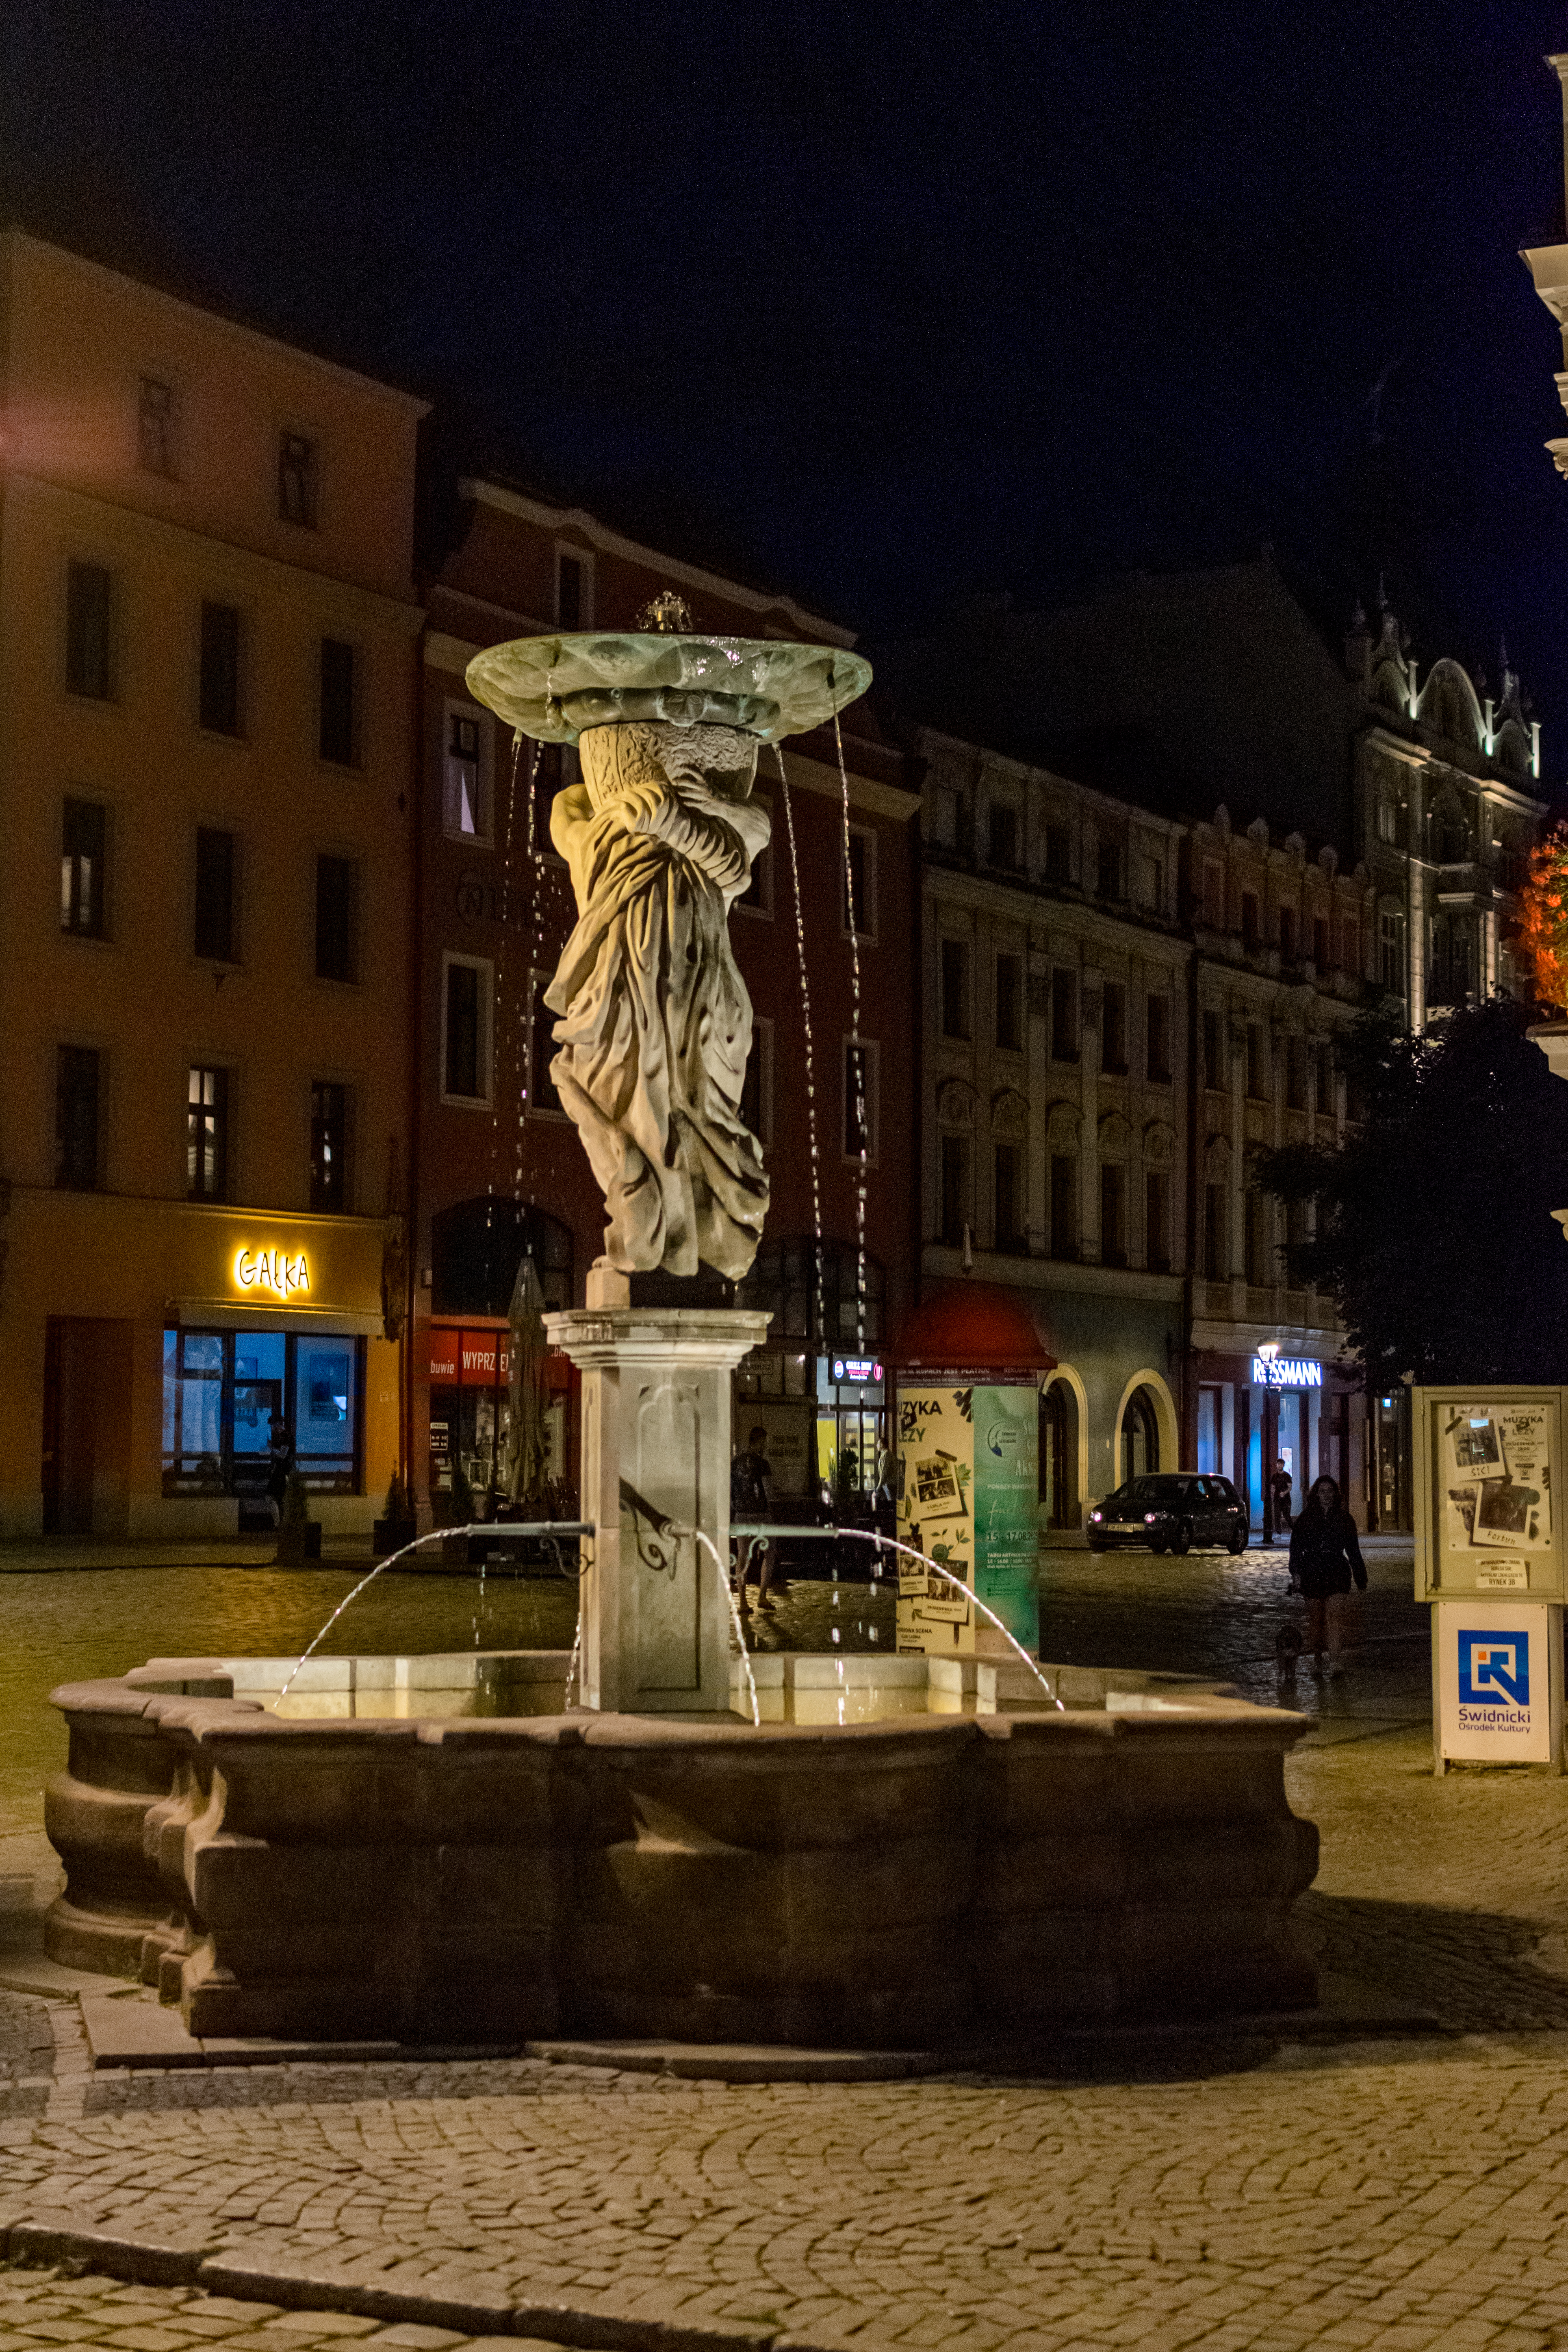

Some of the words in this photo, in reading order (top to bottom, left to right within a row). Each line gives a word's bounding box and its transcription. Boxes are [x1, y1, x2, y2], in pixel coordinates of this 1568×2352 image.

[239, 1250, 310, 1295] GAŁKA
[987, 1532, 998, 1541] 15
[1459, 1705, 1530, 1723] Świdnicki
[1458, 1722, 1495, 1731] Ośrodek
[1498, 1724, 1531, 1734] Kultury
